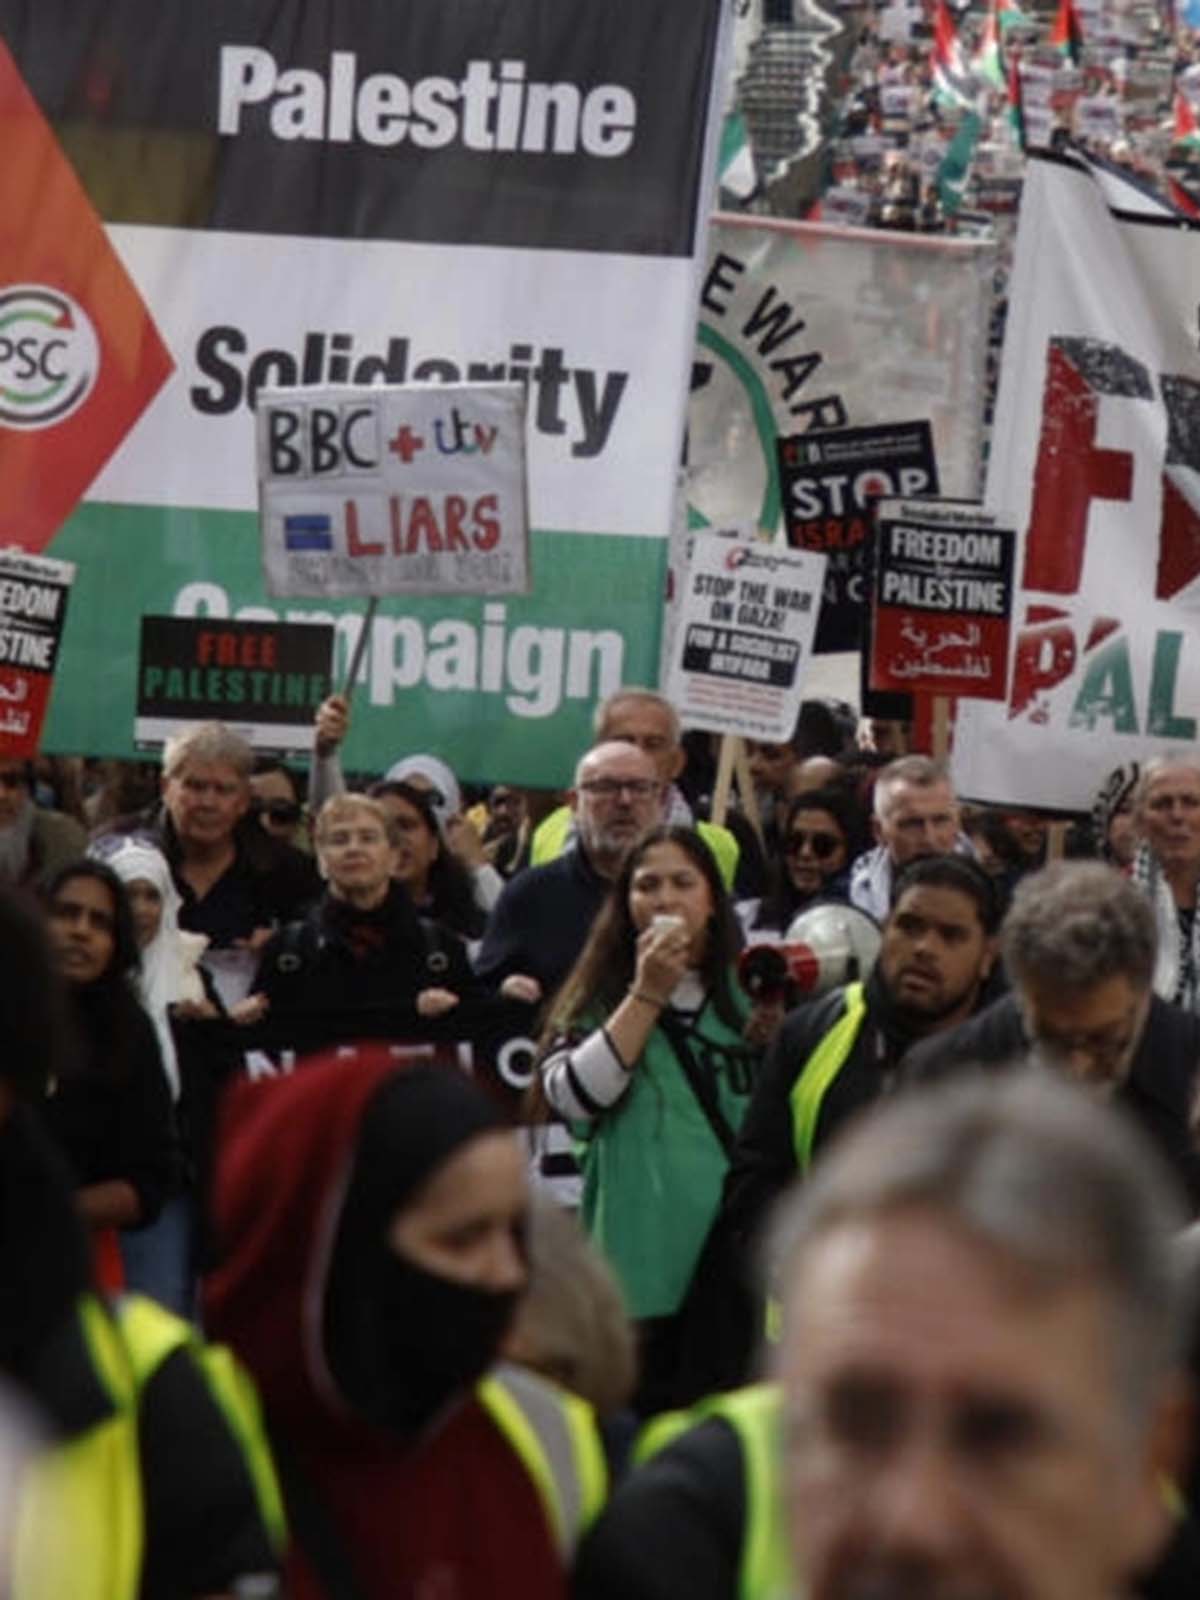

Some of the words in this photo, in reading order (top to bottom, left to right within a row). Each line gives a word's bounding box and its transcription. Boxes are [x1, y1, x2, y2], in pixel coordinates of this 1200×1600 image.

[217, 45, 637, 157] Palestine
[269, 408, 377, 475] BBC
[791, 467, 930, 520] STOP
[345, 493, 500, 557] LIARS
[794, 517, 866, 551] ISRA
[890, 526, 1001, 567] FREEDOM
[882, 570, 1005, 613] PALESTINE
[173, 581, 625, 718] paign
[196, 631, 278, 668] FREE
[900, 617, 981, 649] الحرية
[145, 666, 331, 707] PALESTINE
